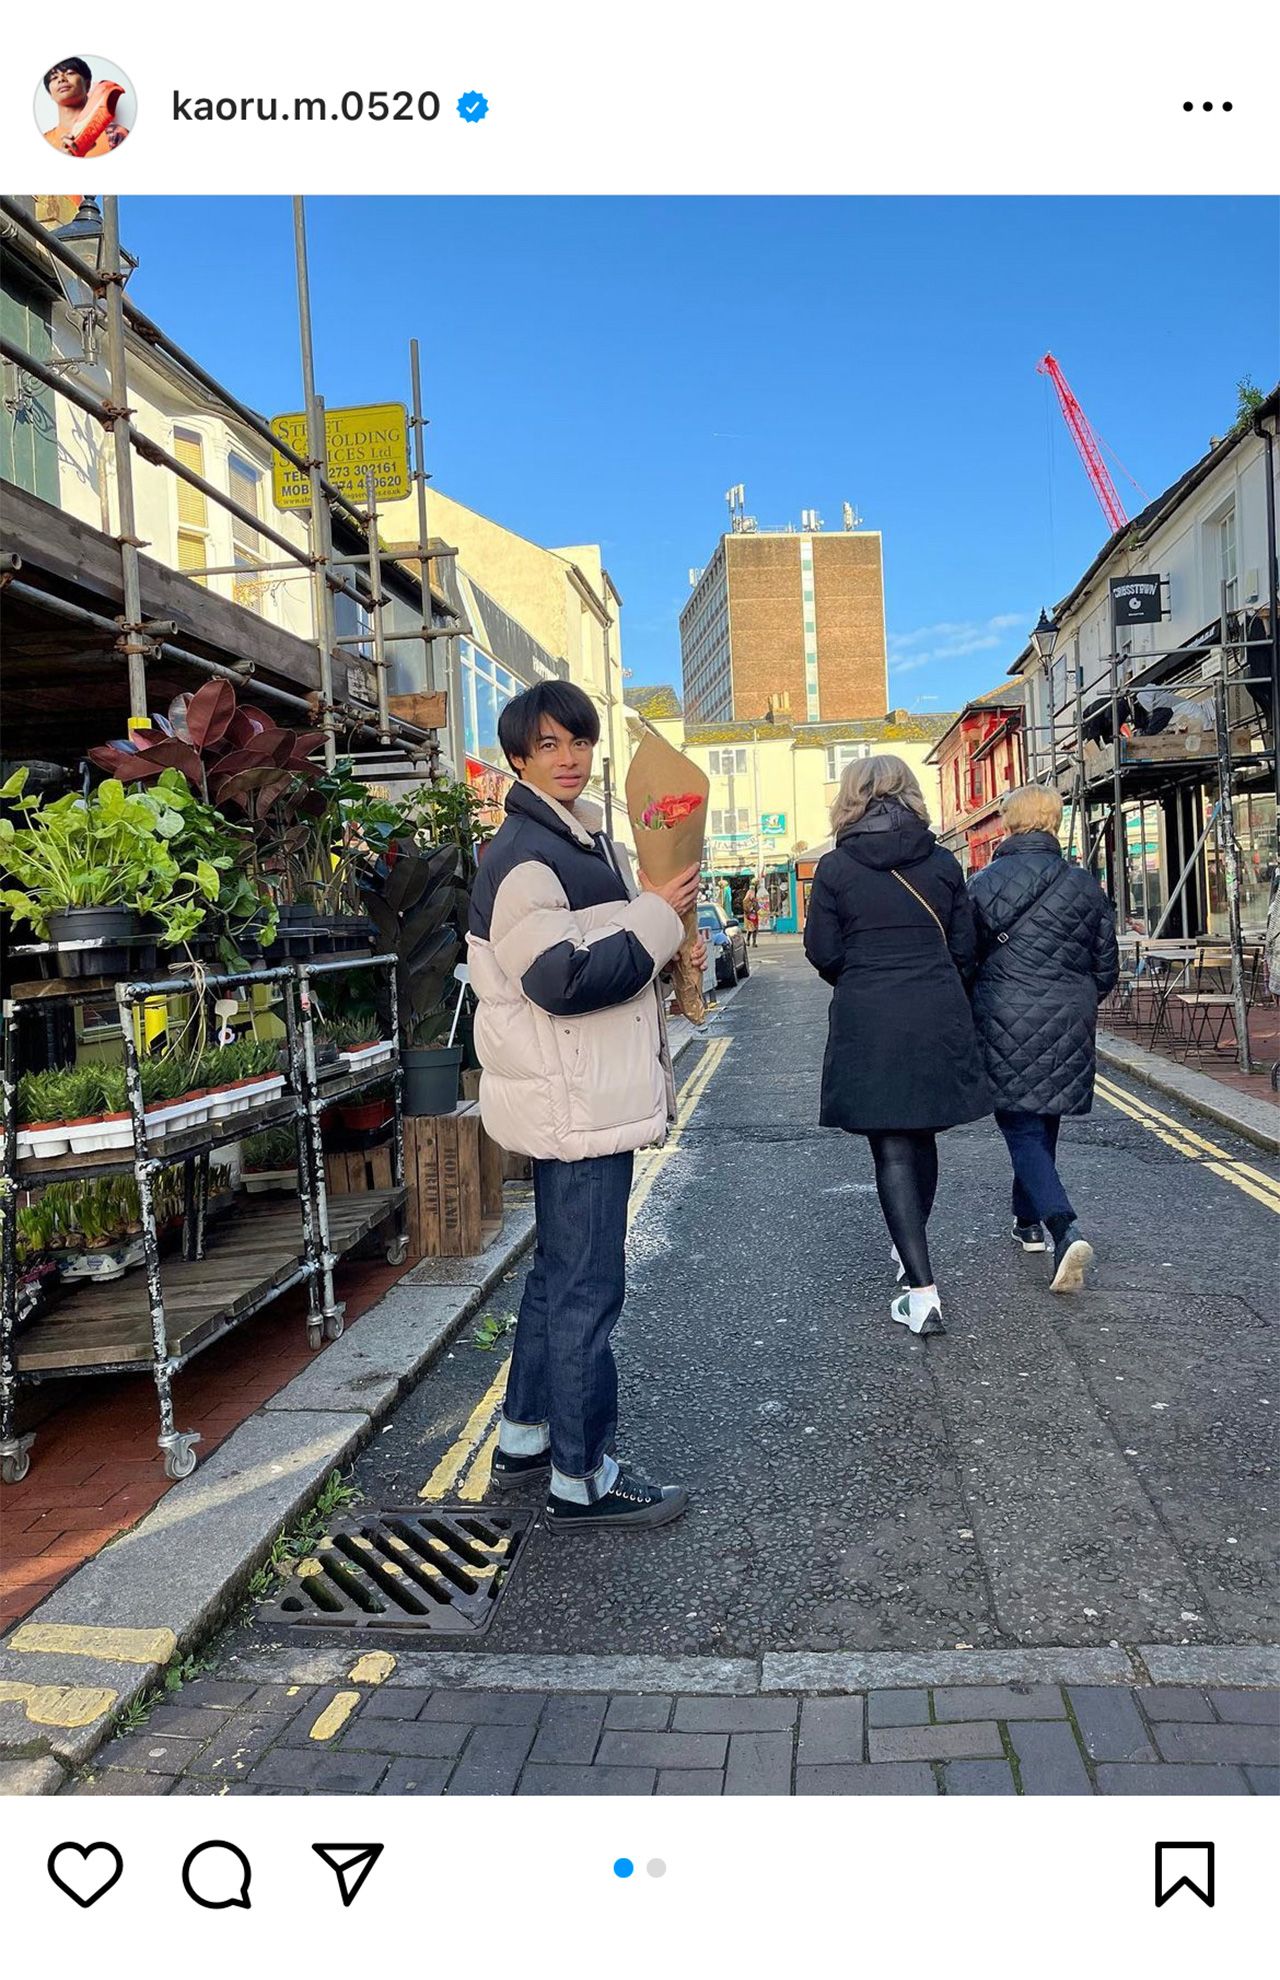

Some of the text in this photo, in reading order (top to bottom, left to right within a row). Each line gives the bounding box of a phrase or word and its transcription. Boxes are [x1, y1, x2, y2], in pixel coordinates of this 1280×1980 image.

[371, 446, 392, 458] Ltd
[354, 462, 397, 477] 302161
[357, 476, 401, 490] 40620
[425, 1162, 438, 1215] FRUIT
[444, 1148, 458, 1229] HOLLAND
